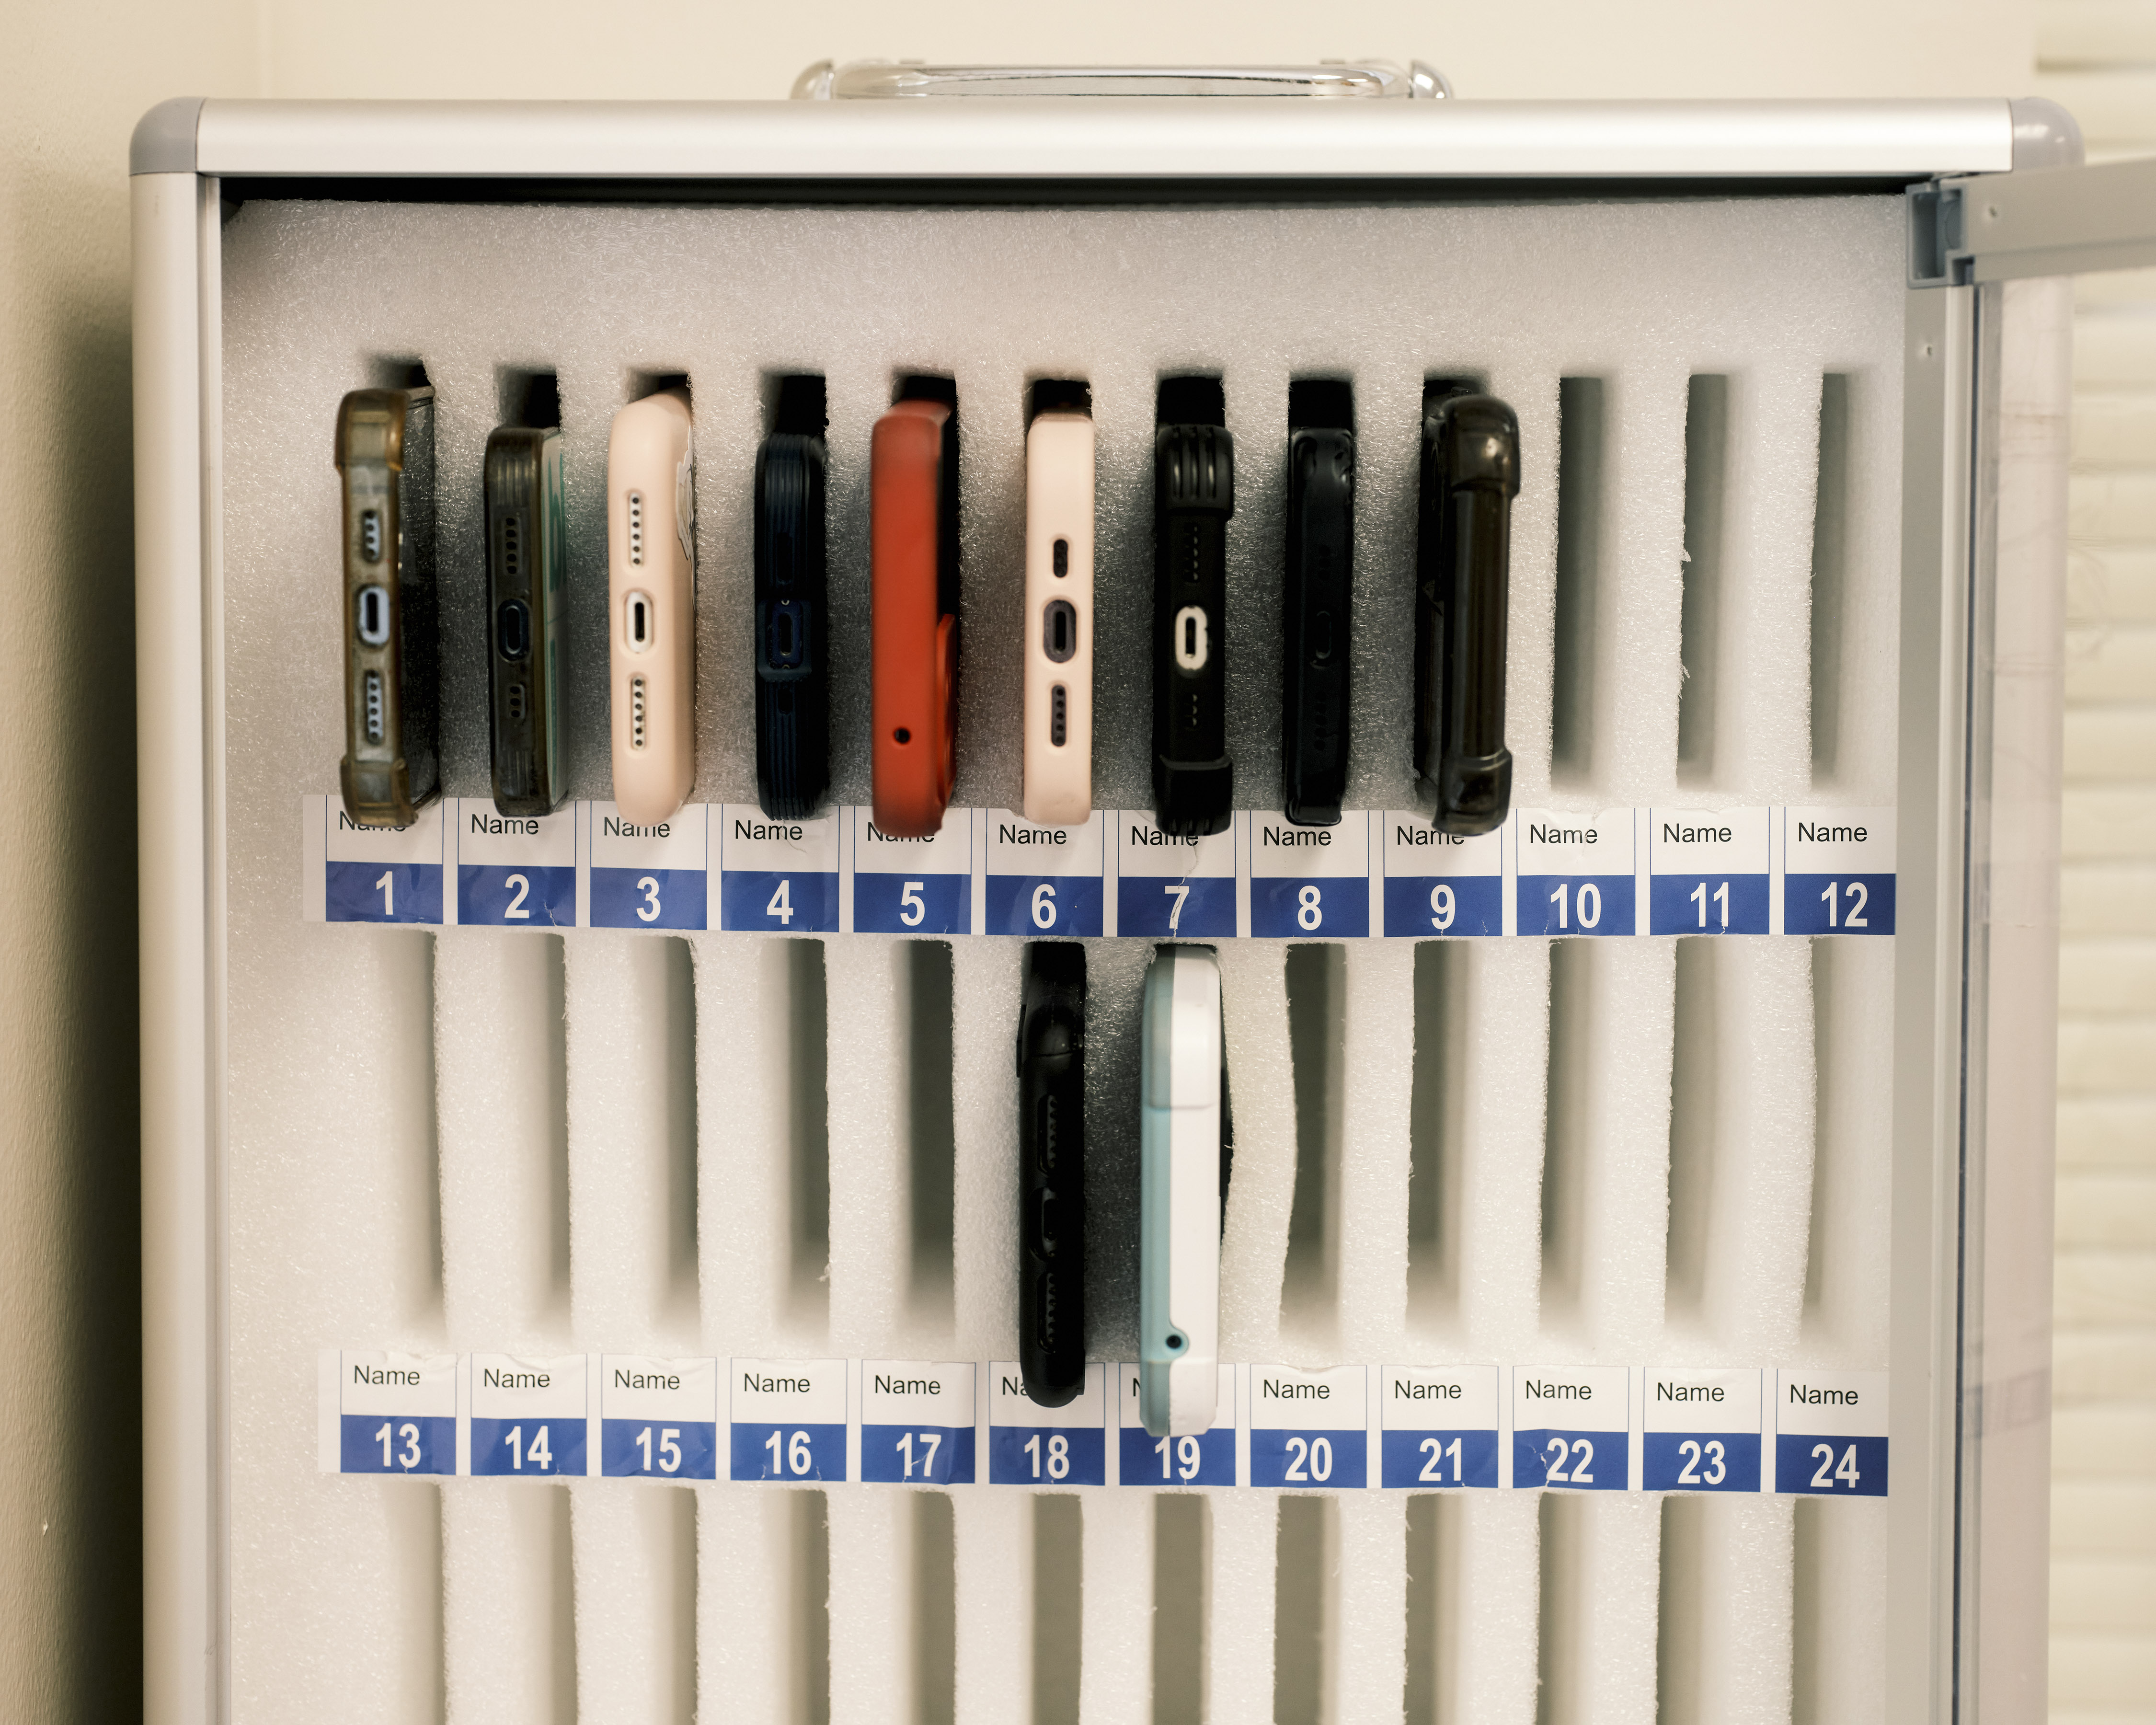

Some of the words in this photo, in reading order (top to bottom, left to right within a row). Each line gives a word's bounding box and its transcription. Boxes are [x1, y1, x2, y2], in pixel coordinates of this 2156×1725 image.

[471, 814, 539, 835] Name
[604, 816, 670, 838] Name
[735, 820, 803, 840] Name
[1000, 824, 1067, 844] Name
[1131, 826, 1199, 846] Name
[1263, 826, 1331, 846] Name
[1397, 826, 1465, 845] Name
[1531, 824, 1597, 843] Name
[1664, 824, 1731, 842] Name
[1799, 823, 1867, 841] Name
[376, 871, 393, 915] 1
[505, 874, 529, 918] 2
[636, 876, 660, 921] 3
[767, 880, 793, 924] 4
[900, 882, 925, 925] 5
[1032, 884, 1056, 928] 6
[1164, 886, 1189, 929] 7
[1298, 886, 1322, 930] 8
[1430, 885, 1455, 930] 9
[1551, 884, 1601, 928] 10
[1690, 882, 1729, 927] 11
[1822, 882, 1868, 927] 12
[355, 1366, 419, 1385] Name
[485, 1369, 550, 1387] Name
[616, 1370, 679, 1389] Name
[745, 1374, 810, 1392] Name
[876, 1375, 940, 1394] Name
[1264, 1380, 1330, 1399] Name
[1396, 1380, 1461, 1399] Name
[1527, 1380, 1591, 1400] Name
[1658, 1383, 1724, 1401] Name
[1791, 1385, 1858, 1405] Name
[375, 1422, 421, 1468] 13
[505, 1426, 552, 1469] 14
[636, 1427, 681, 1472] 15
[766, 1431, 811, 1474] 16
[896, 1432, 941, 1477] 17
[1025, 1435, 1069, 1479] 18
[1154, 1435, 1200, 1479] 19
[1285, 1438, 1332, 1481] 20
[1419, 1438, 1461, 1481] 21
[1547, 1437, 1594, 1483] 22
[1678, 1440, 1726, 1484] 23
[1811, 1444, 1860, 1488] 24
